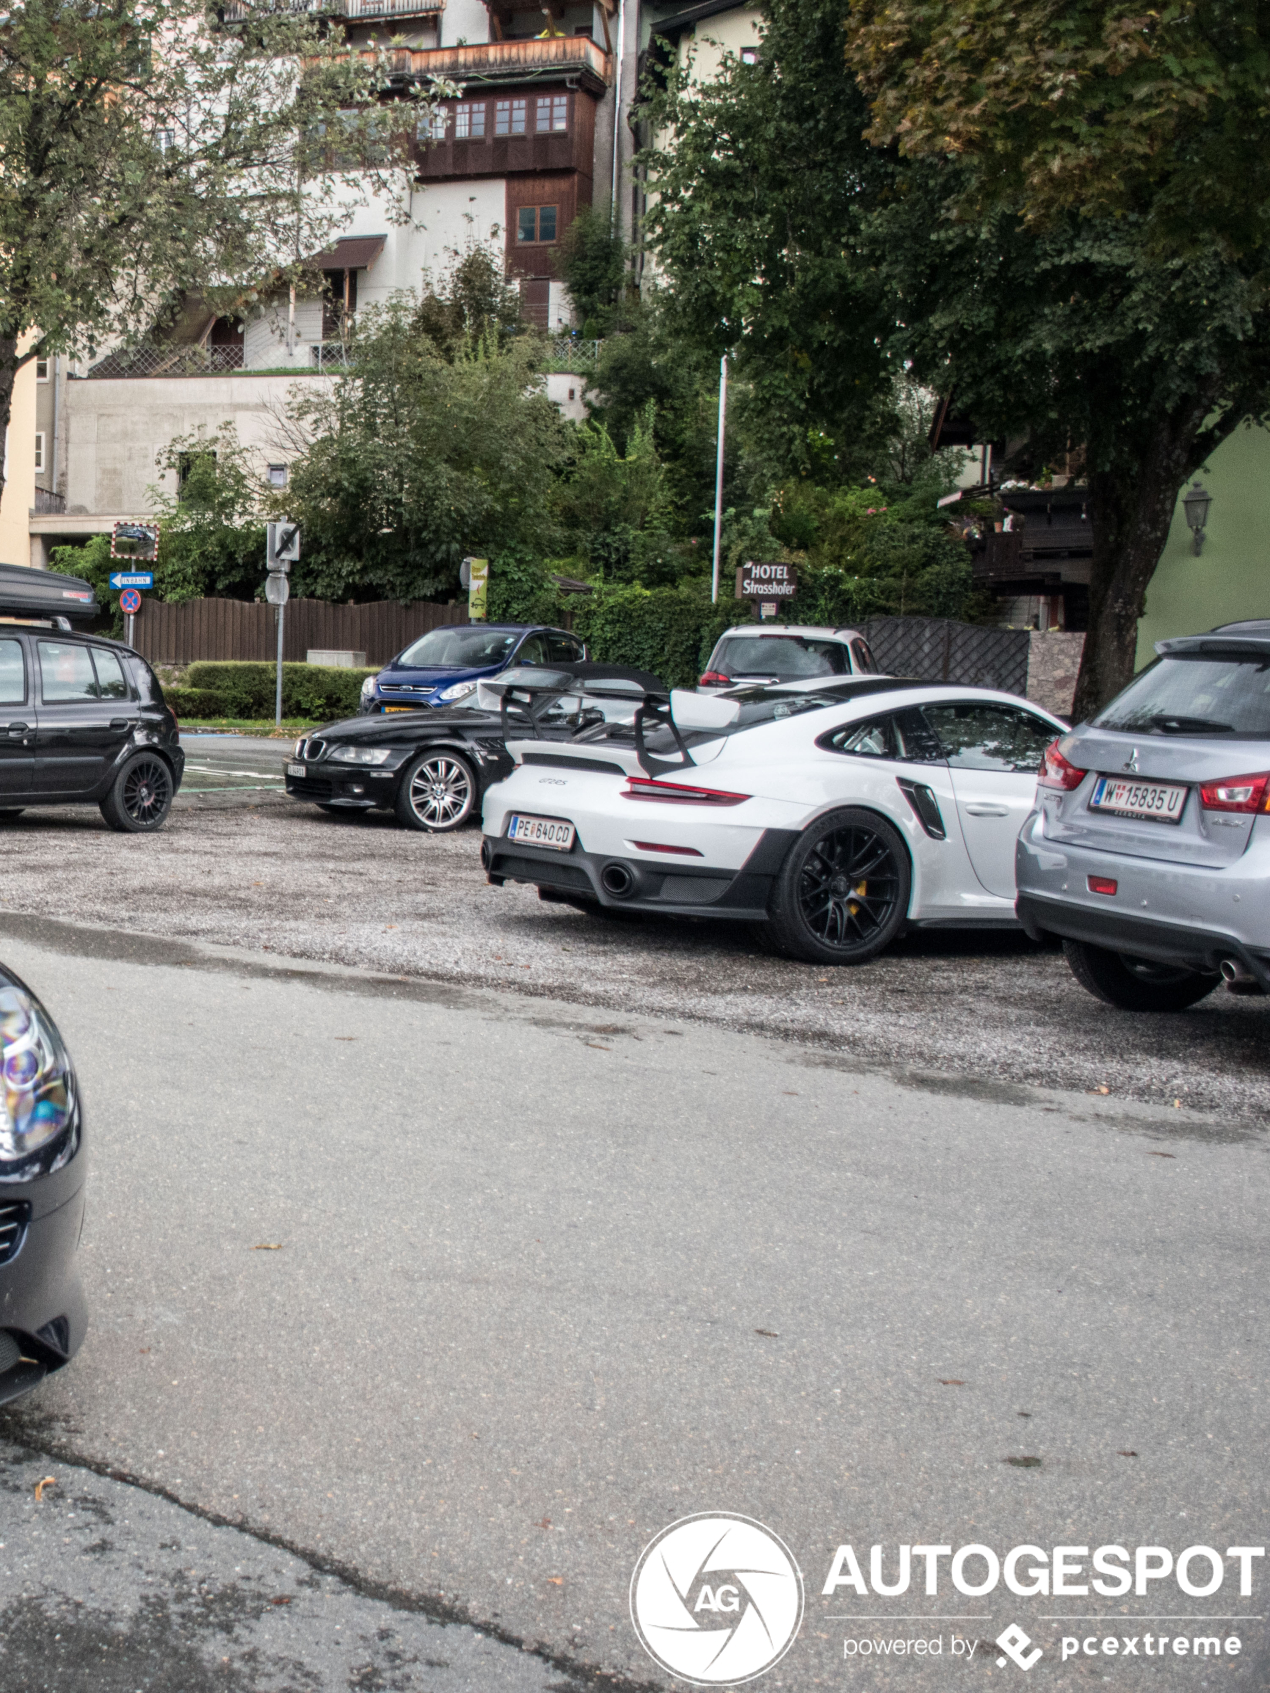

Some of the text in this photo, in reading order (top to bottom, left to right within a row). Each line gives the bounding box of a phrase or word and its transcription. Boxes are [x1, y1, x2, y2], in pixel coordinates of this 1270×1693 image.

[751, 565, 789, 579] HOTEL
[742, 579, 796, 595] Strasshofer
[1105, 783, 1117, 804] W
[1125, 785, 1168, 811] 15835
[1167, 791, 1180, 812] U
[517, 820, 570, 843] PE 640 CD
